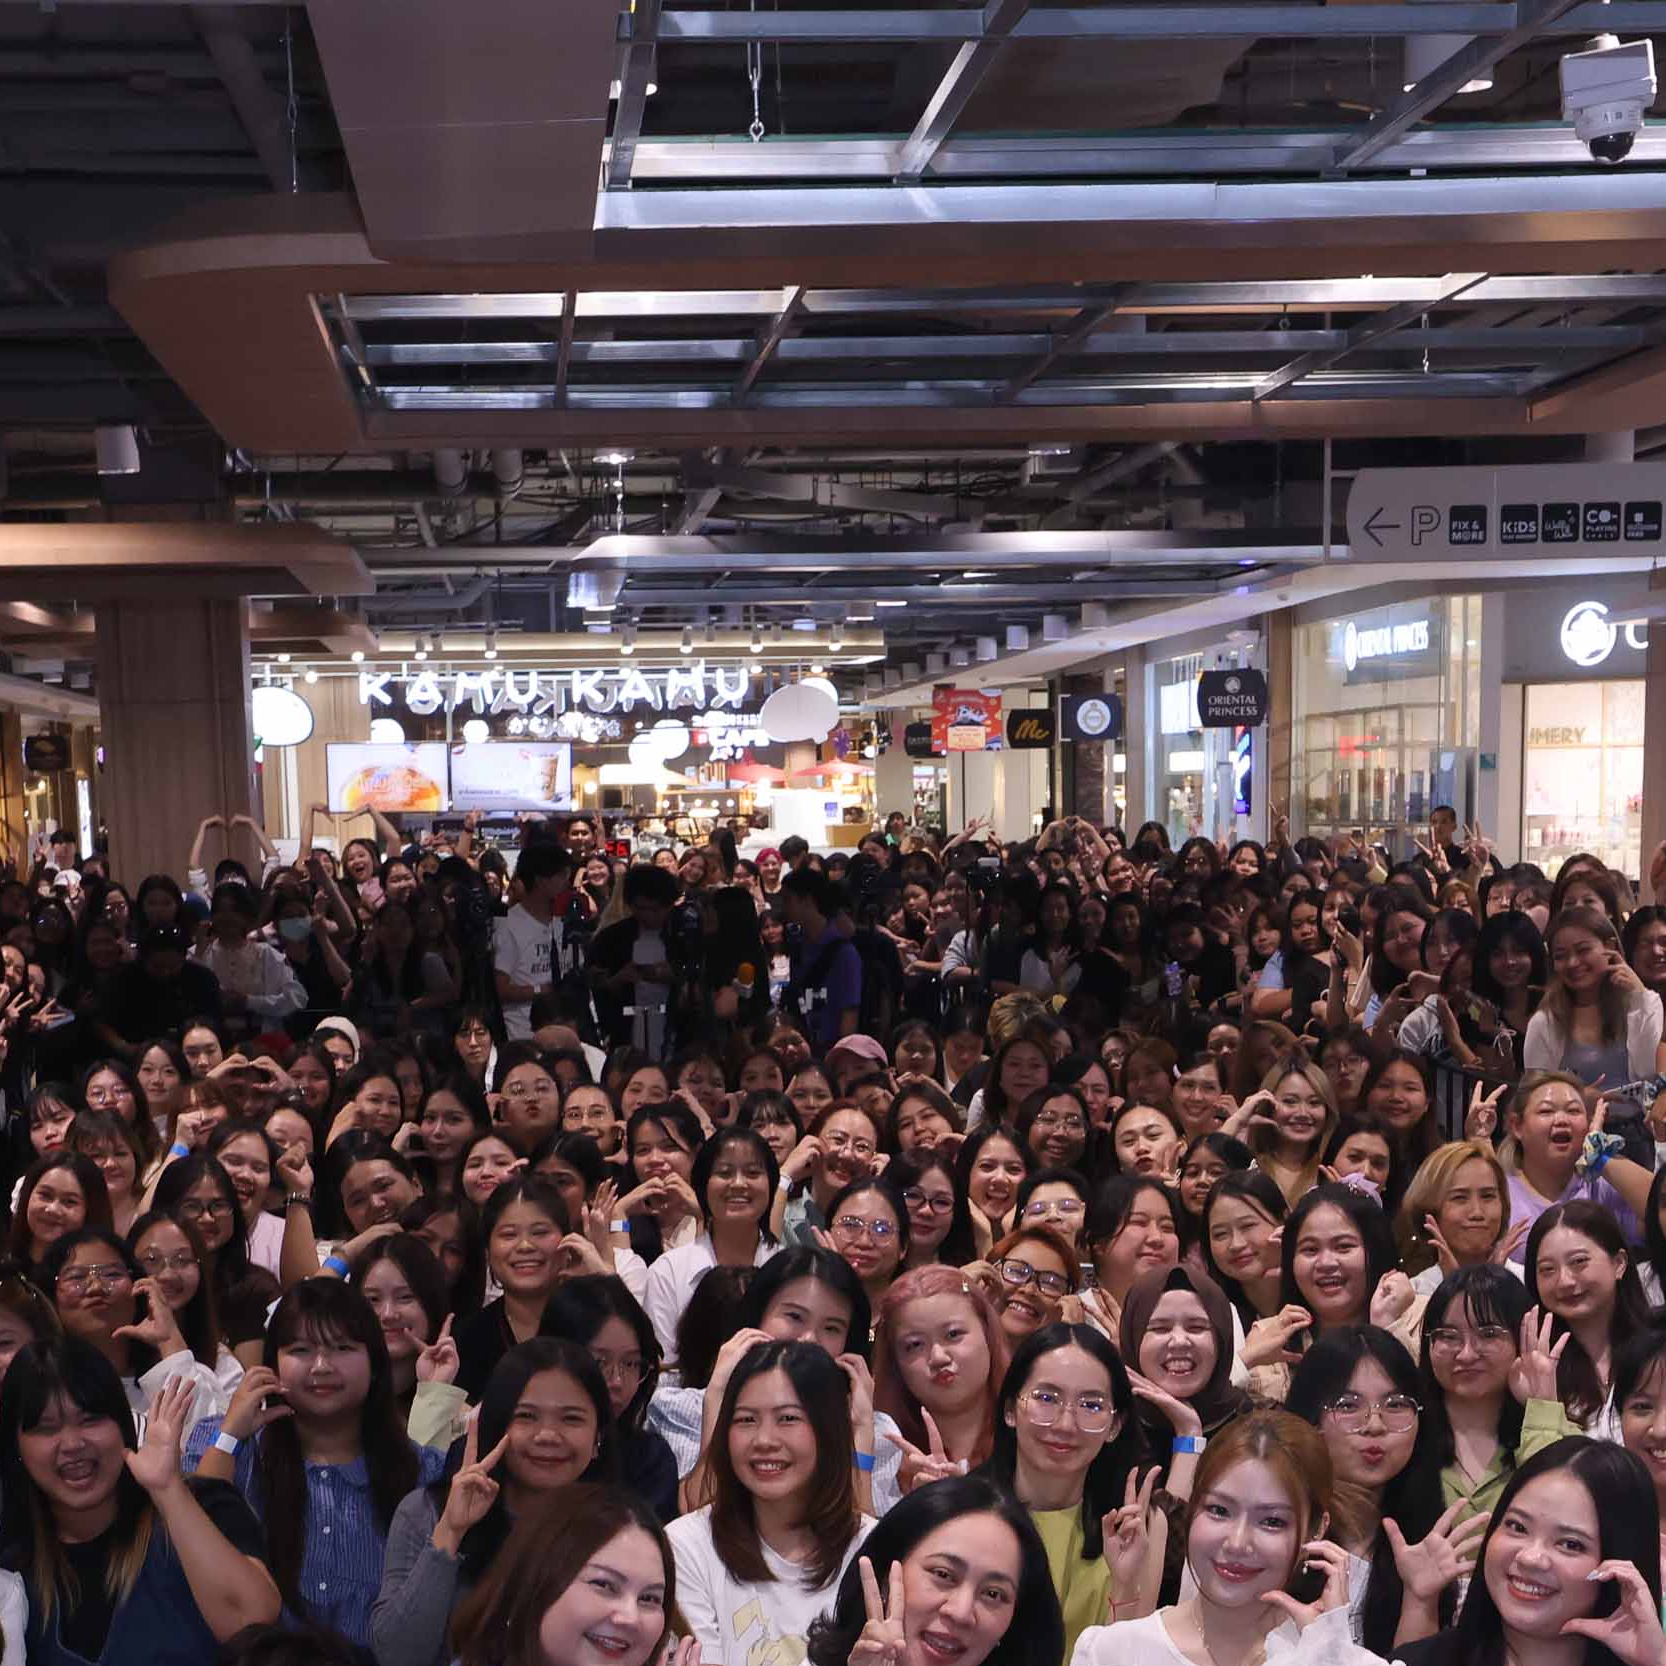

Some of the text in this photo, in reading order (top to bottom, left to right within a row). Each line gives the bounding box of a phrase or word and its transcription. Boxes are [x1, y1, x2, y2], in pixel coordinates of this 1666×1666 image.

[1451, 520, 1469, 530] FIX
[1451, 531, 1485, 541] MORE
[358, 667, 750, 706] KAMU KAMU
[1207, 695, 1258, 706] ORIENTAL
[1207, 706, 1259, 718] PRINCESS
